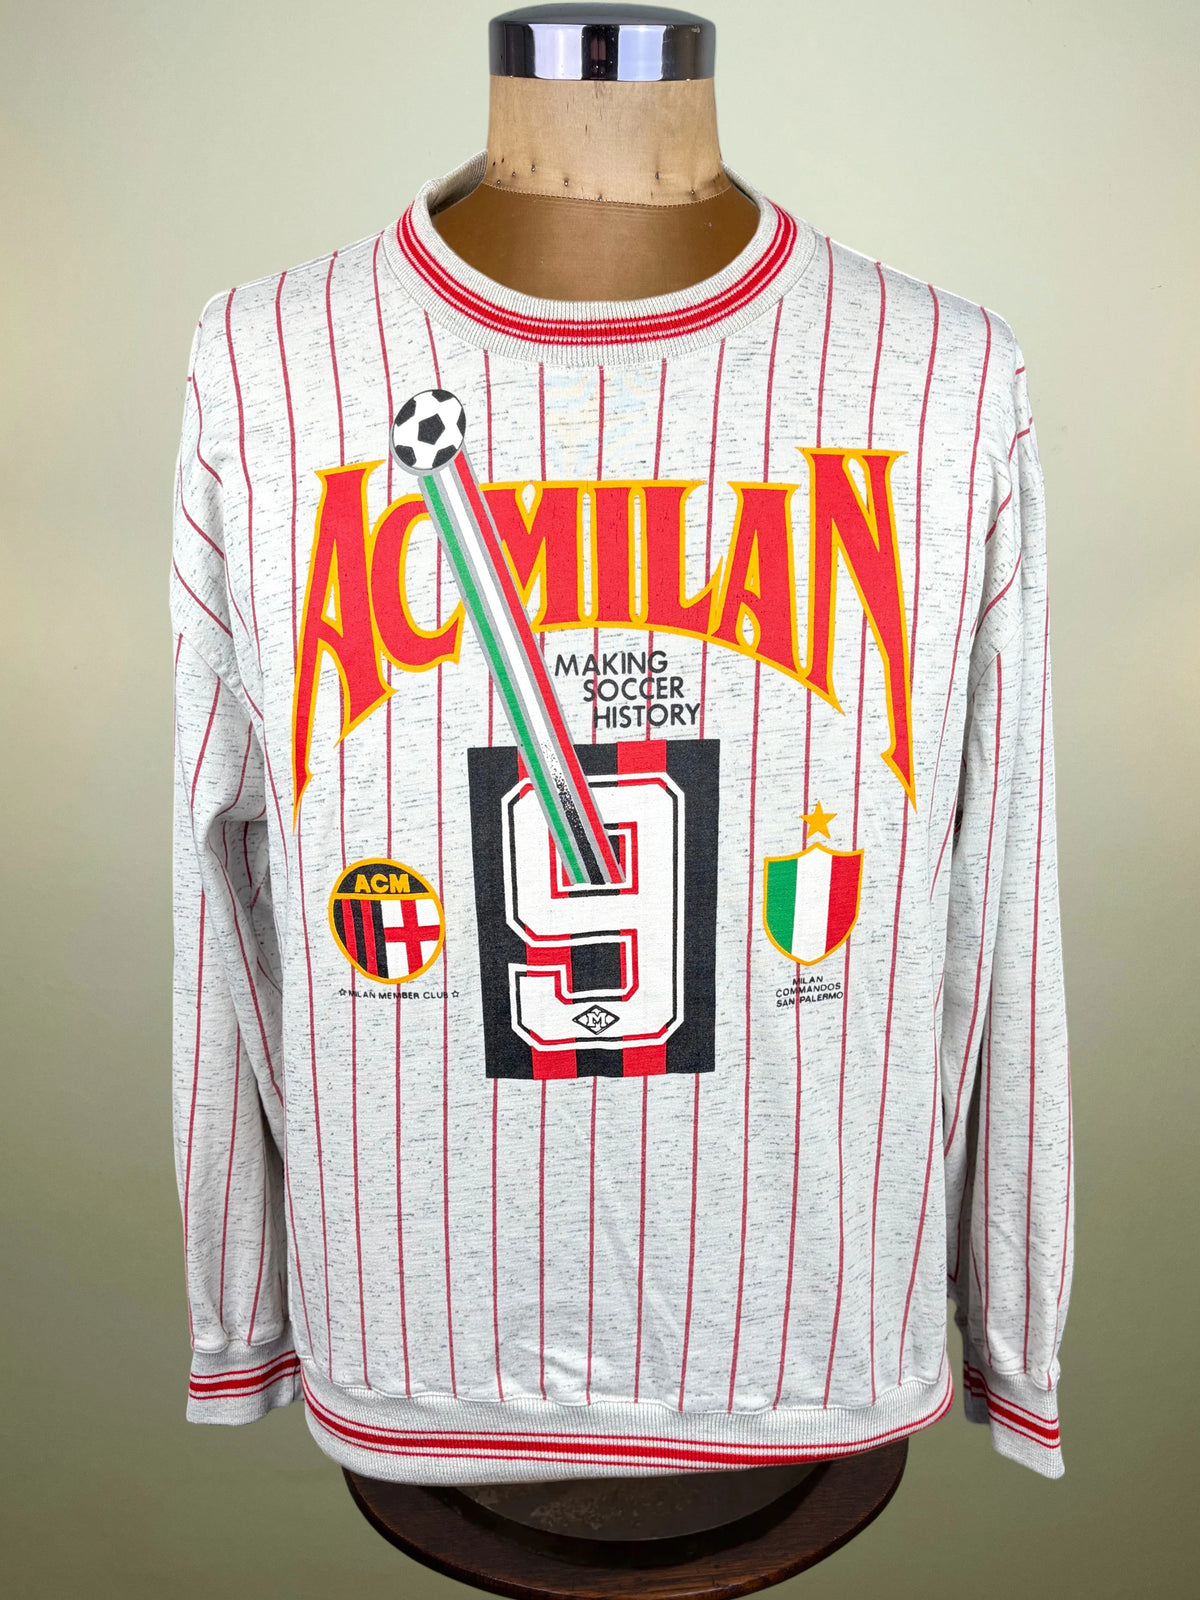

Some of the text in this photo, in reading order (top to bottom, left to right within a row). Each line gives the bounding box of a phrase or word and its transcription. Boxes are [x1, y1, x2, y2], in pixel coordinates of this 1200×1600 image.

[554, 650, 668, 676] MAKING
[583, 676, 685, 702] SOCCER
[594, 703, 701, 728] HISTORY
[354, 873, 411, 894] ACM
[502, 773, 685, 1051] 9
[776, 982, 841, 998] COMMANDOS
[793, 976, 824, 986] MILAN
[349, 990, 449, 1000] MILAN MEMBER CLUB
[776, 991, 844, 1008] SAN PALERMO
